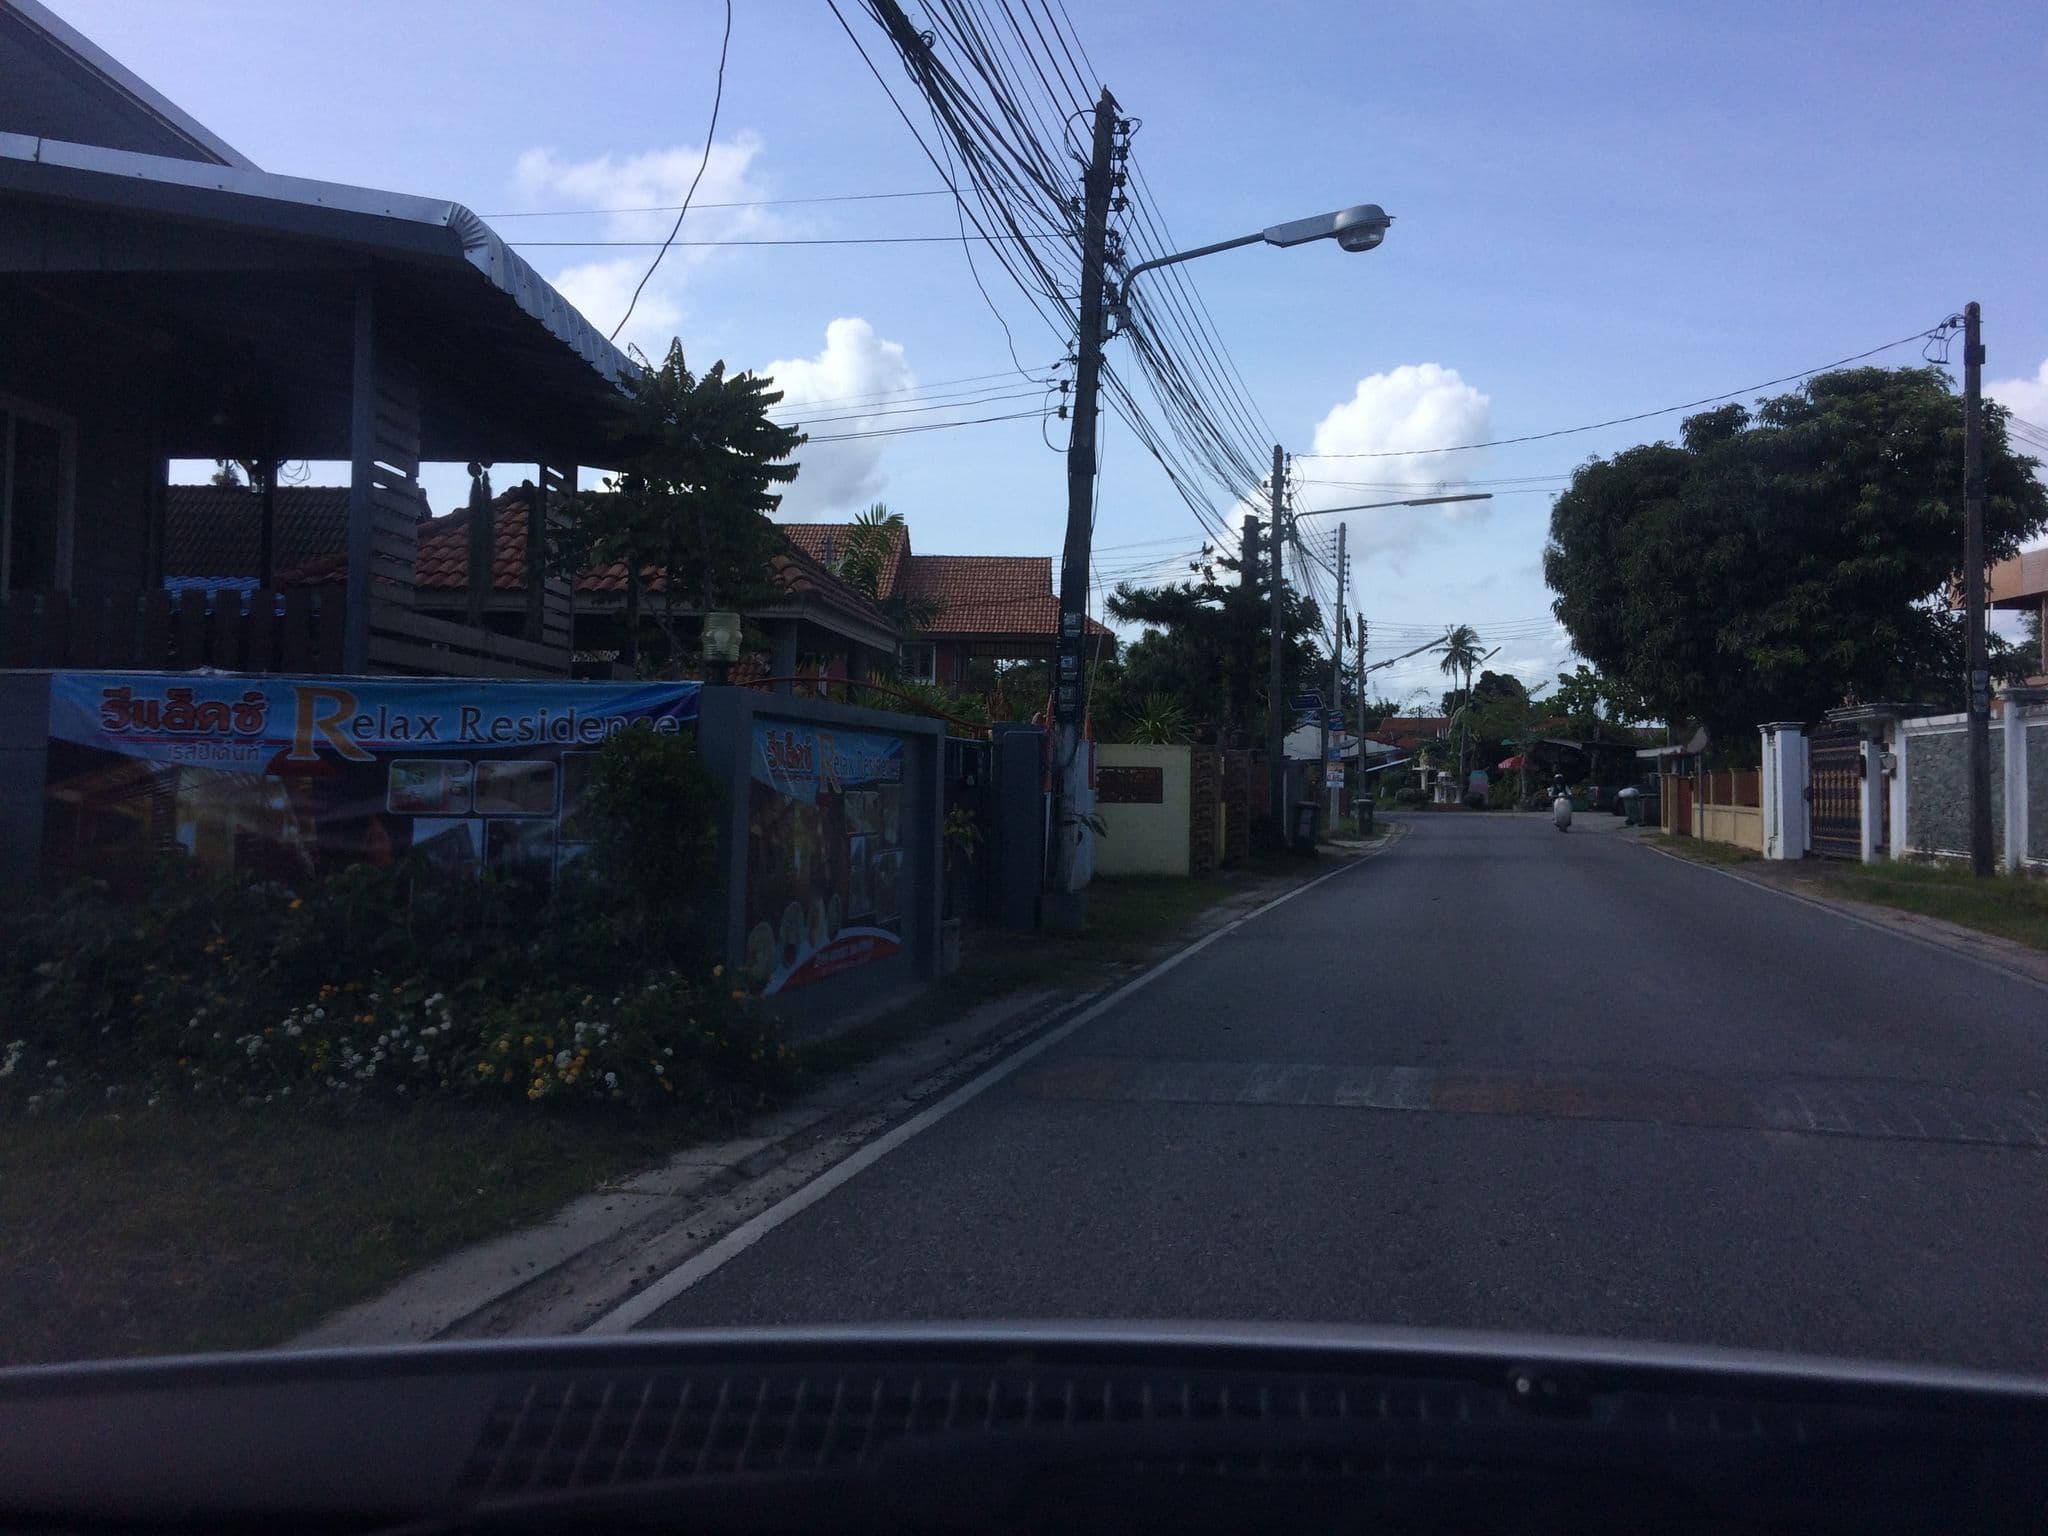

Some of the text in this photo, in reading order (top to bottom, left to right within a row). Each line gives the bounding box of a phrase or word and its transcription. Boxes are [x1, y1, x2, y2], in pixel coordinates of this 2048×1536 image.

[101, 686, 266, 735] รีแล็คซ์
[286, 686, 440, 762] Relax
